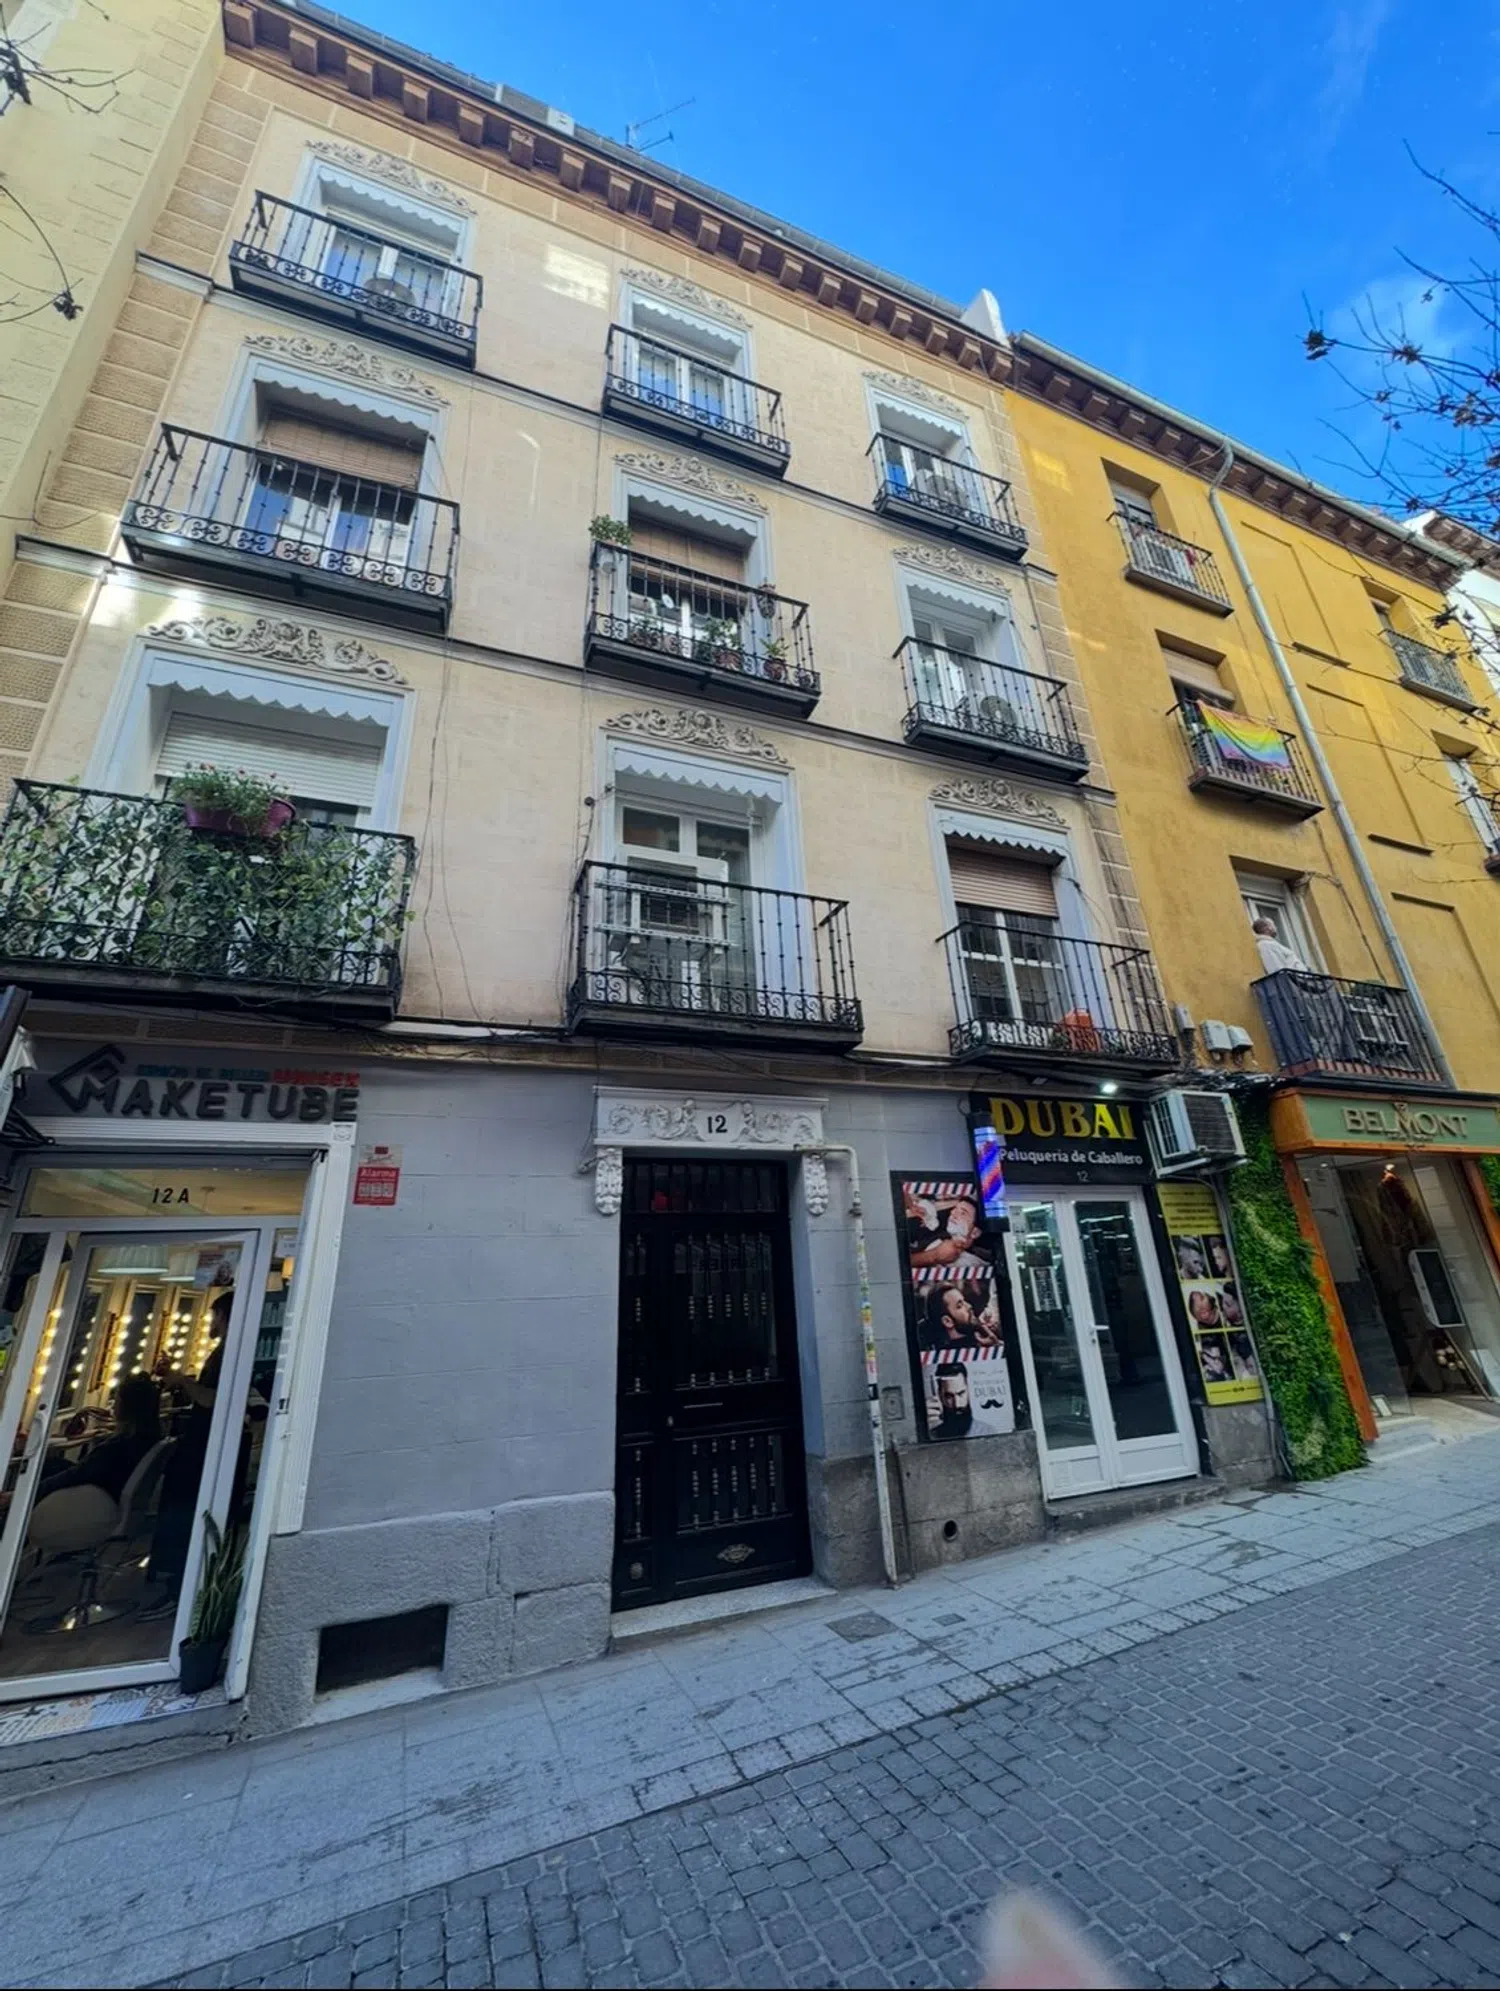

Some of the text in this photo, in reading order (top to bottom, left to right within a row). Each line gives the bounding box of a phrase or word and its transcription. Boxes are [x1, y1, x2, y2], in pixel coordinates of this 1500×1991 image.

[75, 1076, 360, 1122] MAKETUBE
[707, 1114, 728, 1133] 12
[988, 1097, 1137, 1140] DUBAI
[1342, 1103, 1468, 1138] BELMONT
[1071, 1150, 1086, 1163] de
[1088, 1151, 1143, 1165] Caballero
[360, 1168, 397, 1178] Alarma
[1076, 1170, 1089, 1182] 12
